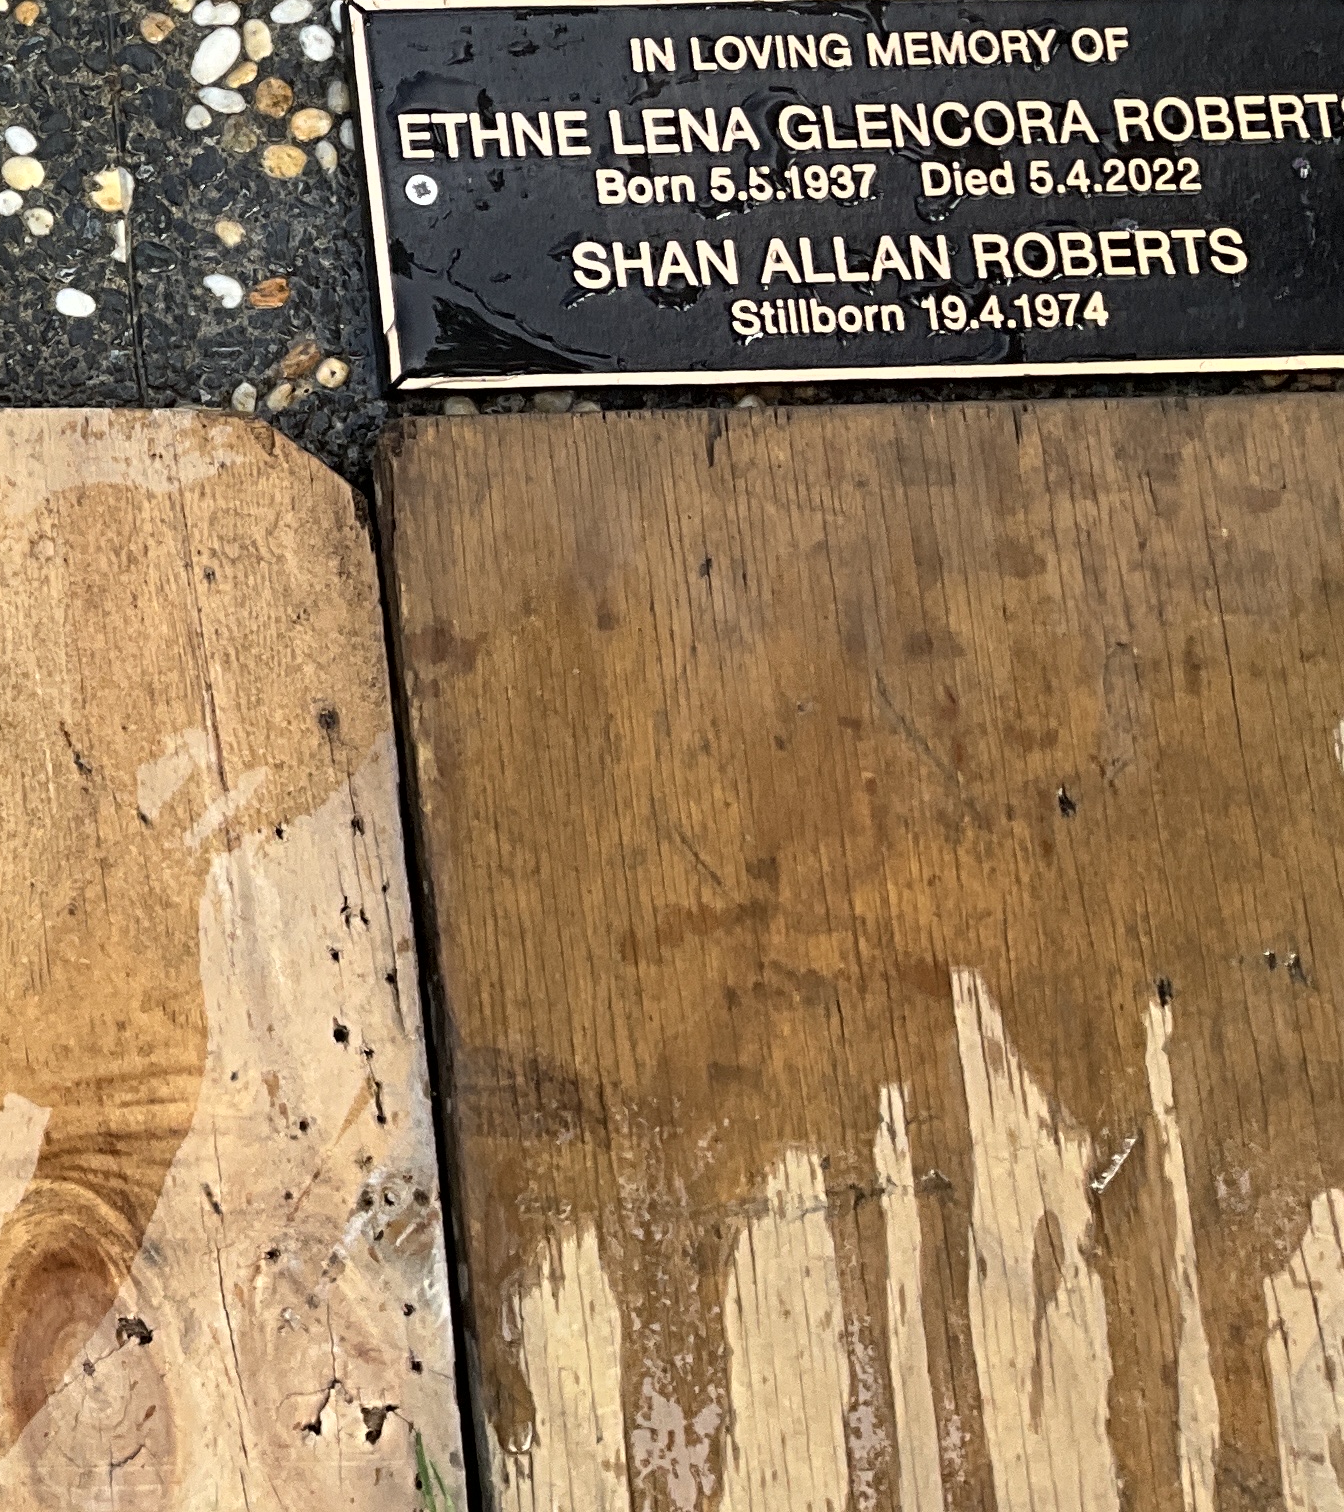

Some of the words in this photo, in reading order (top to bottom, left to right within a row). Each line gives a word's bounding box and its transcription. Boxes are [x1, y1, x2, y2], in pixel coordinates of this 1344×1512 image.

[629, 36, 677, 74] IN
[689, 32, 854, 72] LOVING
[865, 27, 1057, 68] MEMORY
[1070, 26, 1130, 64] OF
[396, 109, 593, 160] ETHNE
[607, 105, 762, 156] LENA
[777, 98, 1101, 152] GLENCORA
[1112, 93, 1344, 143] ROBERT
[594, 167, 697, 206] Born
[709, 162, 878, 203] 5.5.1937
[919, 159, 1016, 198] Died
[1028, 156, 1203, 195] 5.4.2022
[571, 238, 740, 290] SHAN
[760, 233, 953, 285] ALLAN
[971, 226, 1249, 280] ROBERTS
[730, 297, 907, 339] Stillborn
[919, 290, 1110, 332] 19.4.1974
